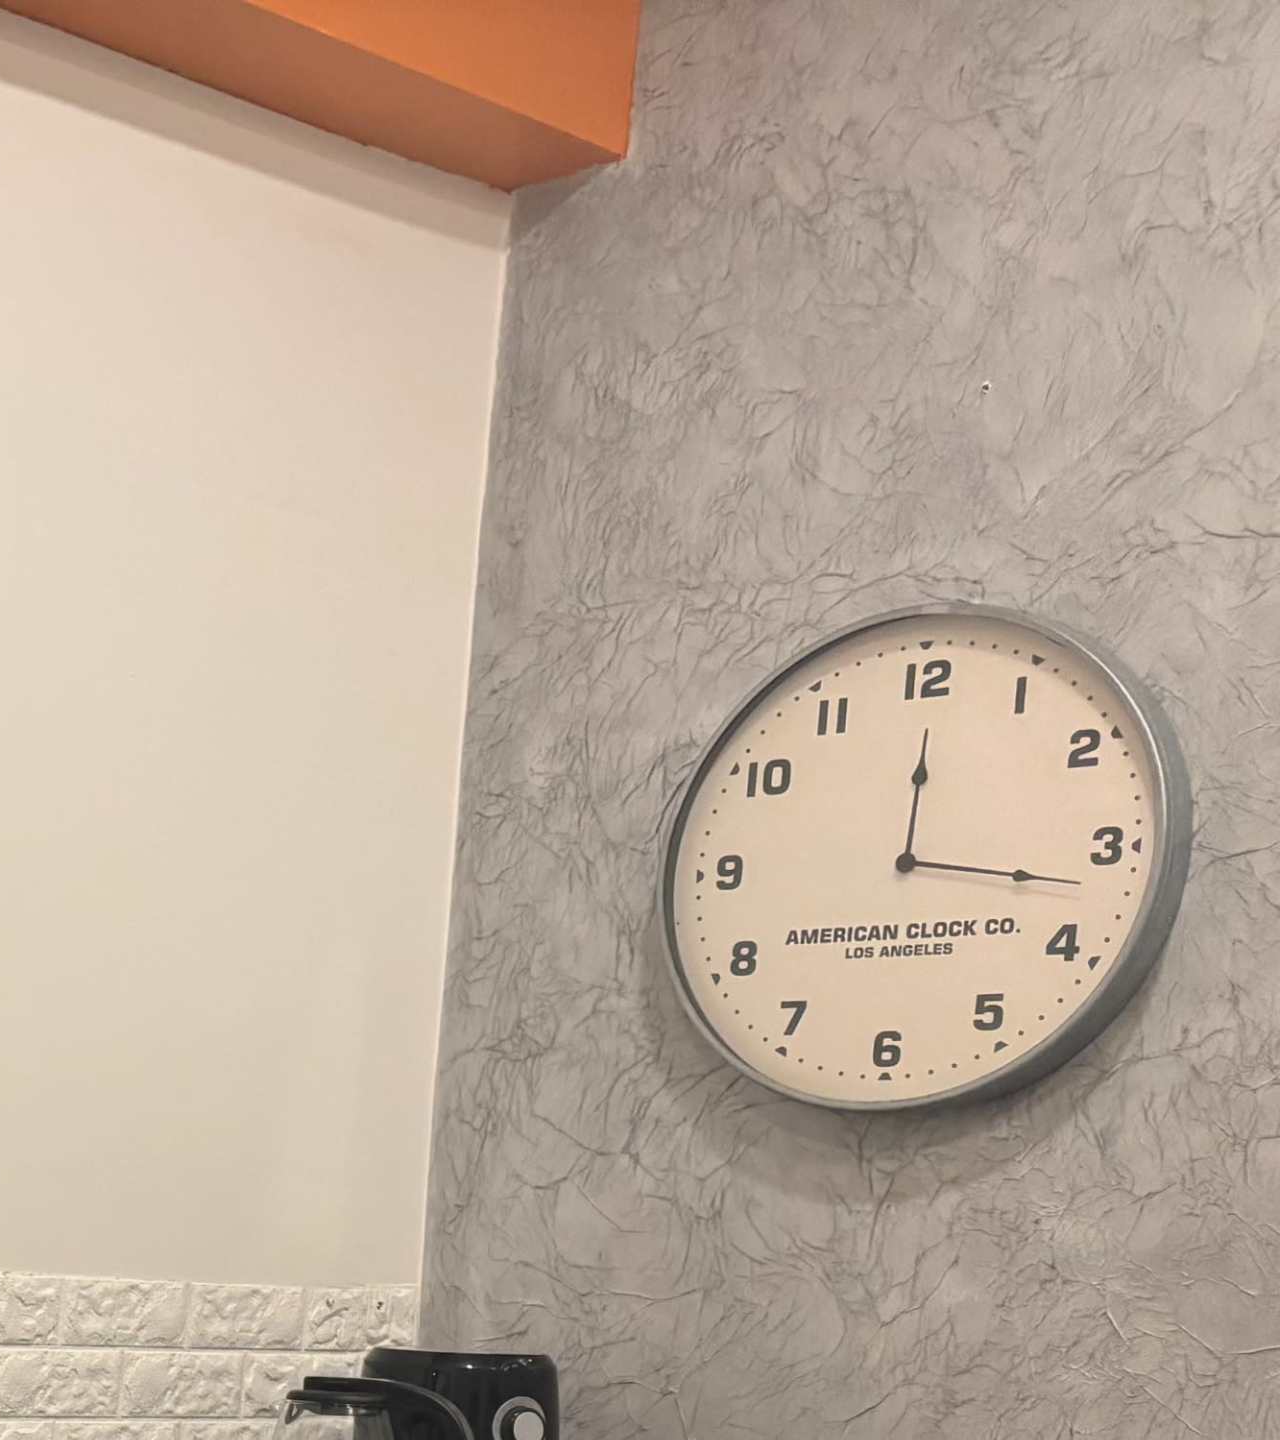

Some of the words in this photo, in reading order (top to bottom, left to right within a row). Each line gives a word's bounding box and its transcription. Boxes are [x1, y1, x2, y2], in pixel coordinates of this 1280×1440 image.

[904, 659, 952, 701] 12
[1014, 676, 1028, 715] 1
[816, 697, 849, 736] 11
[1067, 728, 1101, 769] 2
[746, 758, 792, 798] 10
[1090, 826, 1124, 866] 3
[715, 854, 744, 891] 9
[785, 924, 899, 946] AMERICAN
[905, 919, 978, 940] CLOCK
[984, 917, 1021, 936] CO.
[1045, 923, 1081, 962] 4
[729, 940, 758, 977] 8
[844, 946, 875, 960] LOS
[879, 942, 954, 958] ANGELES
[780, 1000, 808, 1036] 7
[972, 993, 1004, 1031] 5
[872, 1030, 902, 1068] 6
